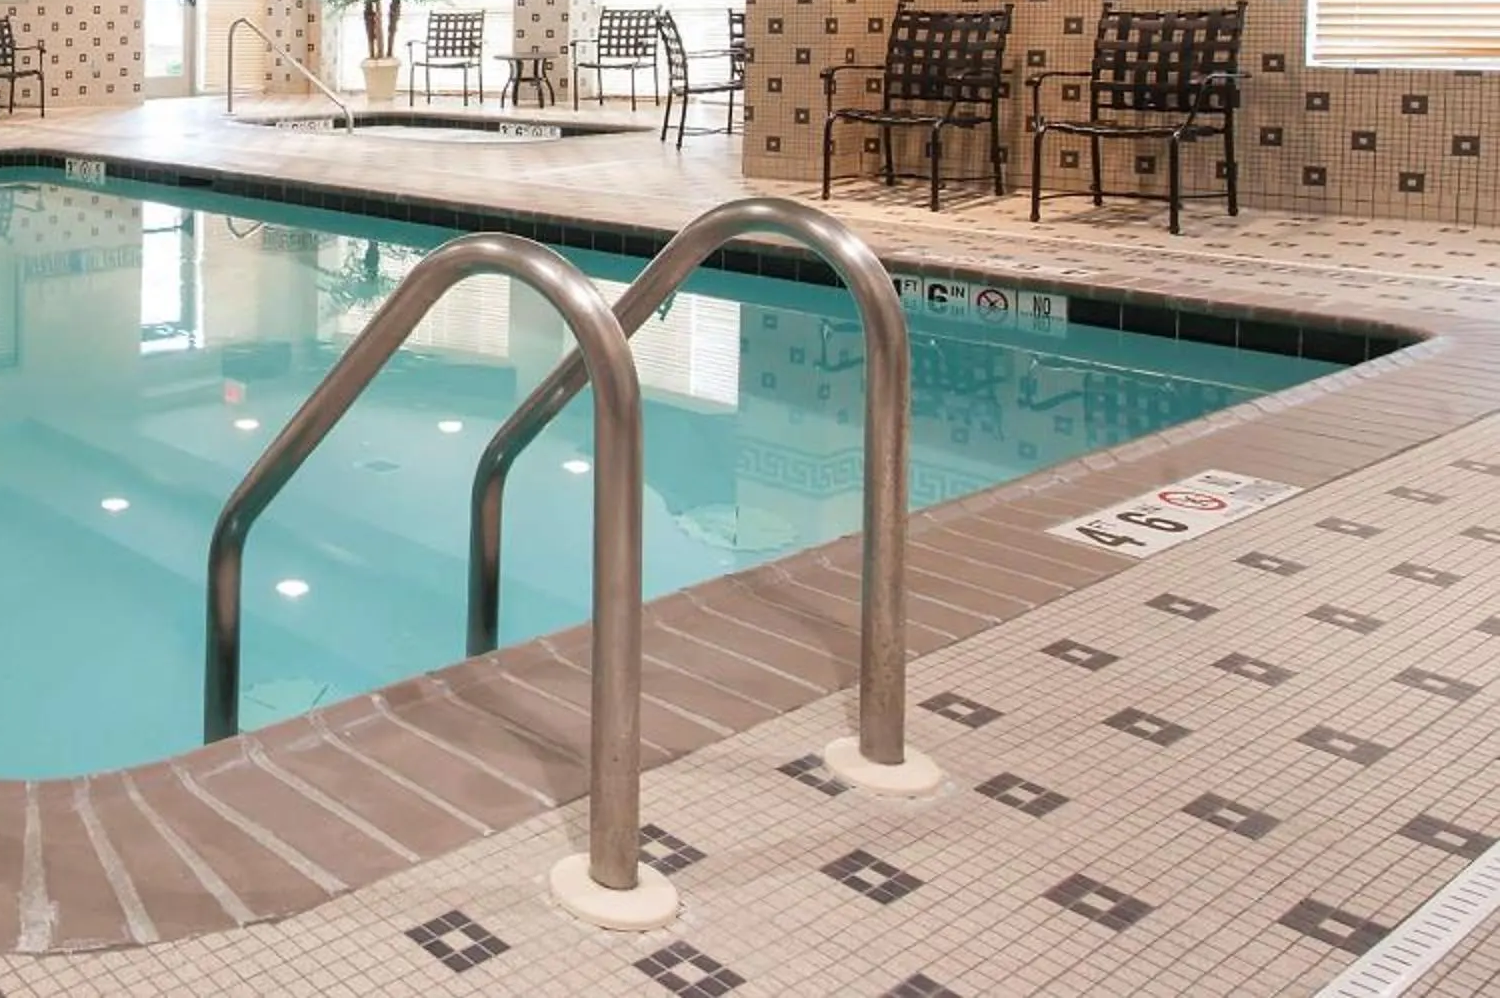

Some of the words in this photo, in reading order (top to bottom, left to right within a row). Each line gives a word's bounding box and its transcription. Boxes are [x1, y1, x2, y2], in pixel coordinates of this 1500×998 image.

[904, 278, 918, 292] FT
[951, 285, 966, 298] IN
[1033, 295, 1051, 317] NO
[1075, 526, 1146, 547] 4
[1115, 511, 1189, 533] 6
